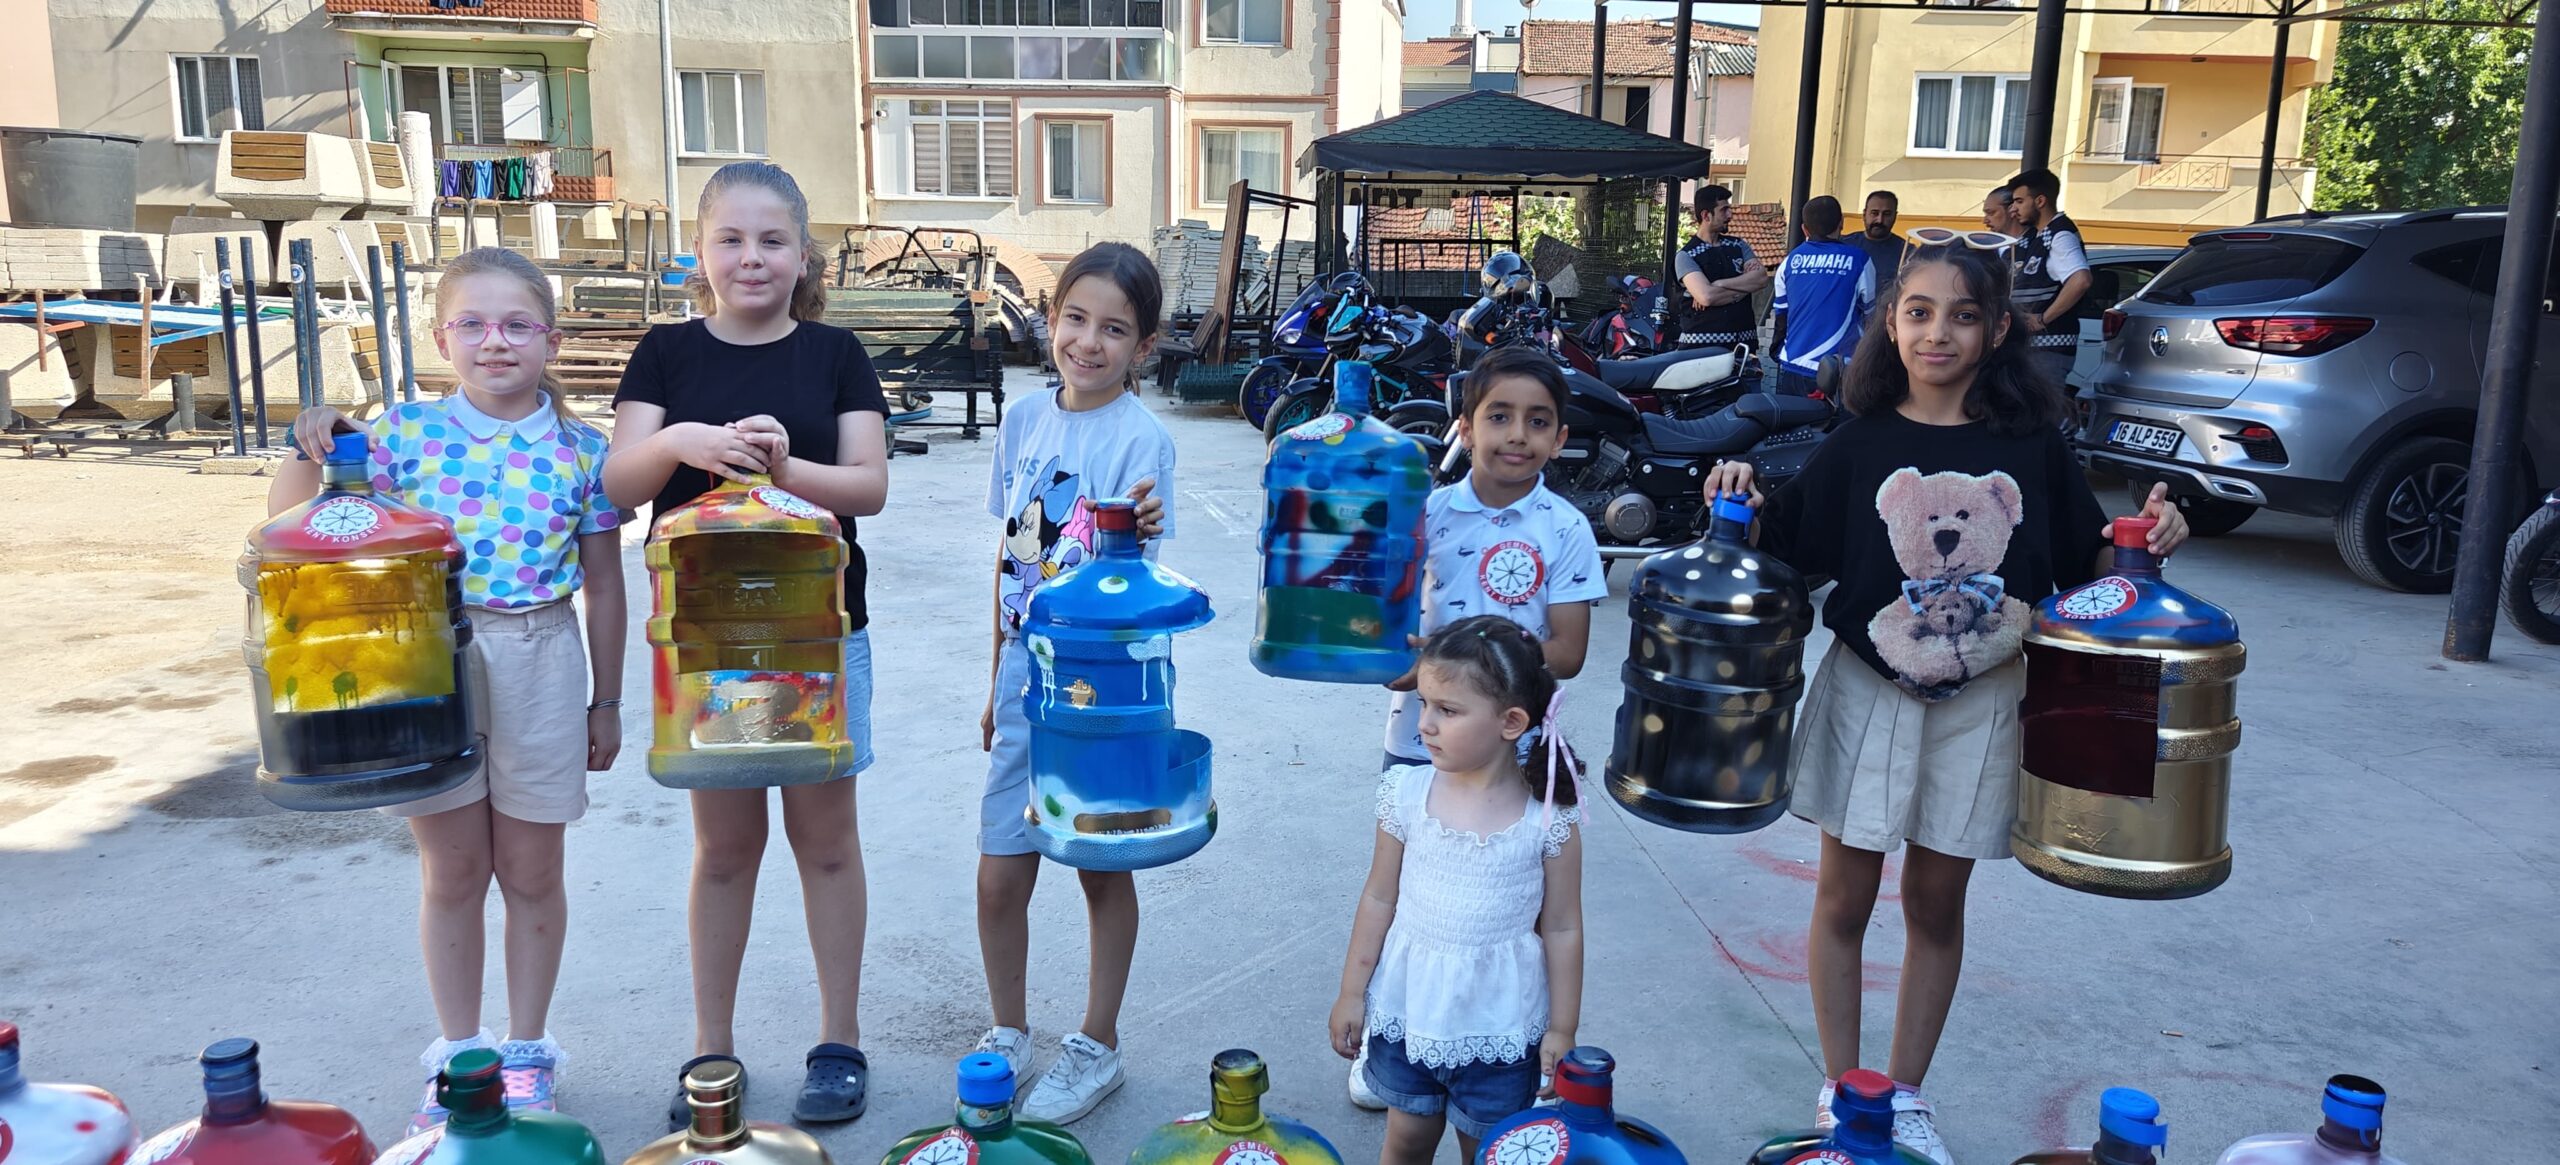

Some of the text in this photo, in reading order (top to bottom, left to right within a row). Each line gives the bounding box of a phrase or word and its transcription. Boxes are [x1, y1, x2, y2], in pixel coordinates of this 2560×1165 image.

[1801, 254, 1853, 270] YAMAHA
[1791, 268, 1847, 276] RACING
[2115, 423, 2177, 449] 16 ALP 559
[1229, 1141, 1277, 1158] GEMLIK
